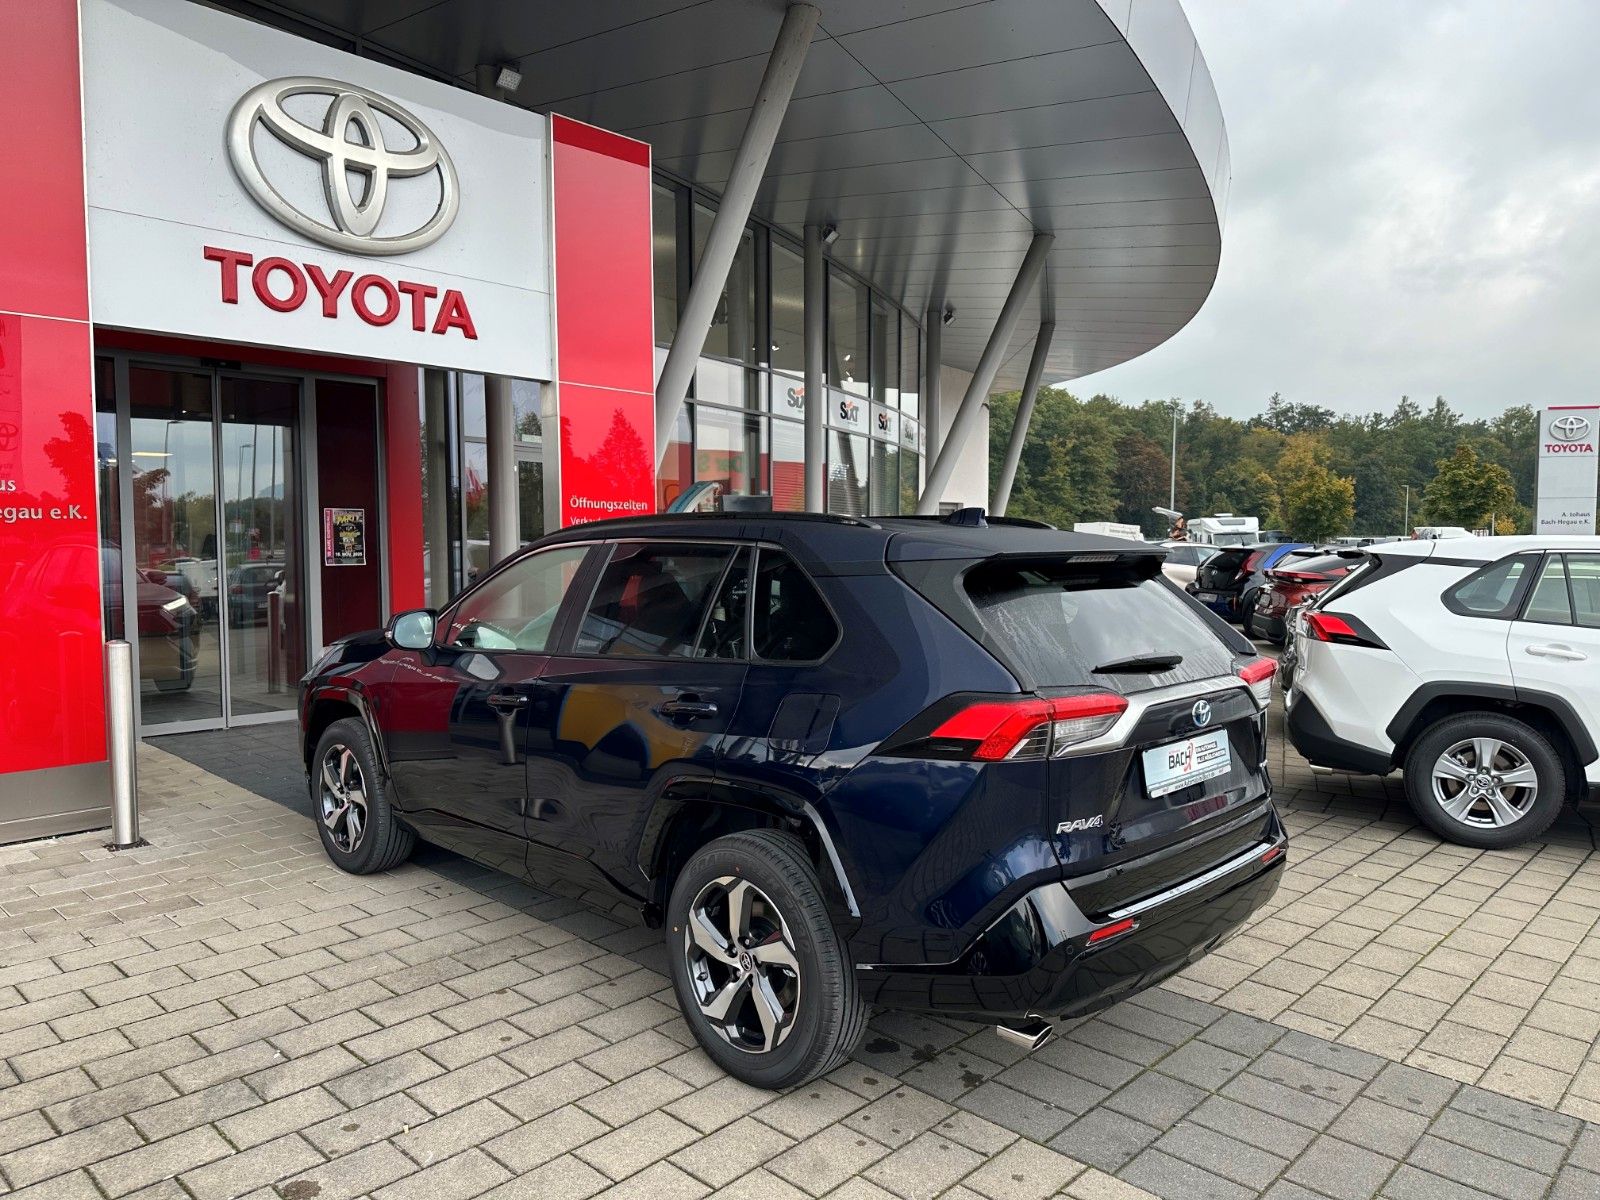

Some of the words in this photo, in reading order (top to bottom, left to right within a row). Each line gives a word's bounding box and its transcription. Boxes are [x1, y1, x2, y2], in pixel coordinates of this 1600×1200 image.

[204, 245, 478, 340] TOYOTA
[1545, 443, 1593, 453] TOYOTA
[49, 504, 88, 519] e.K.
[570, 495, 648, 512] Öffnungszeiten
[570, 516, 601, 525] Verk
[1168, 750, 1191, 769] BACH
[1056, 814, 1103, 834] RAV4
